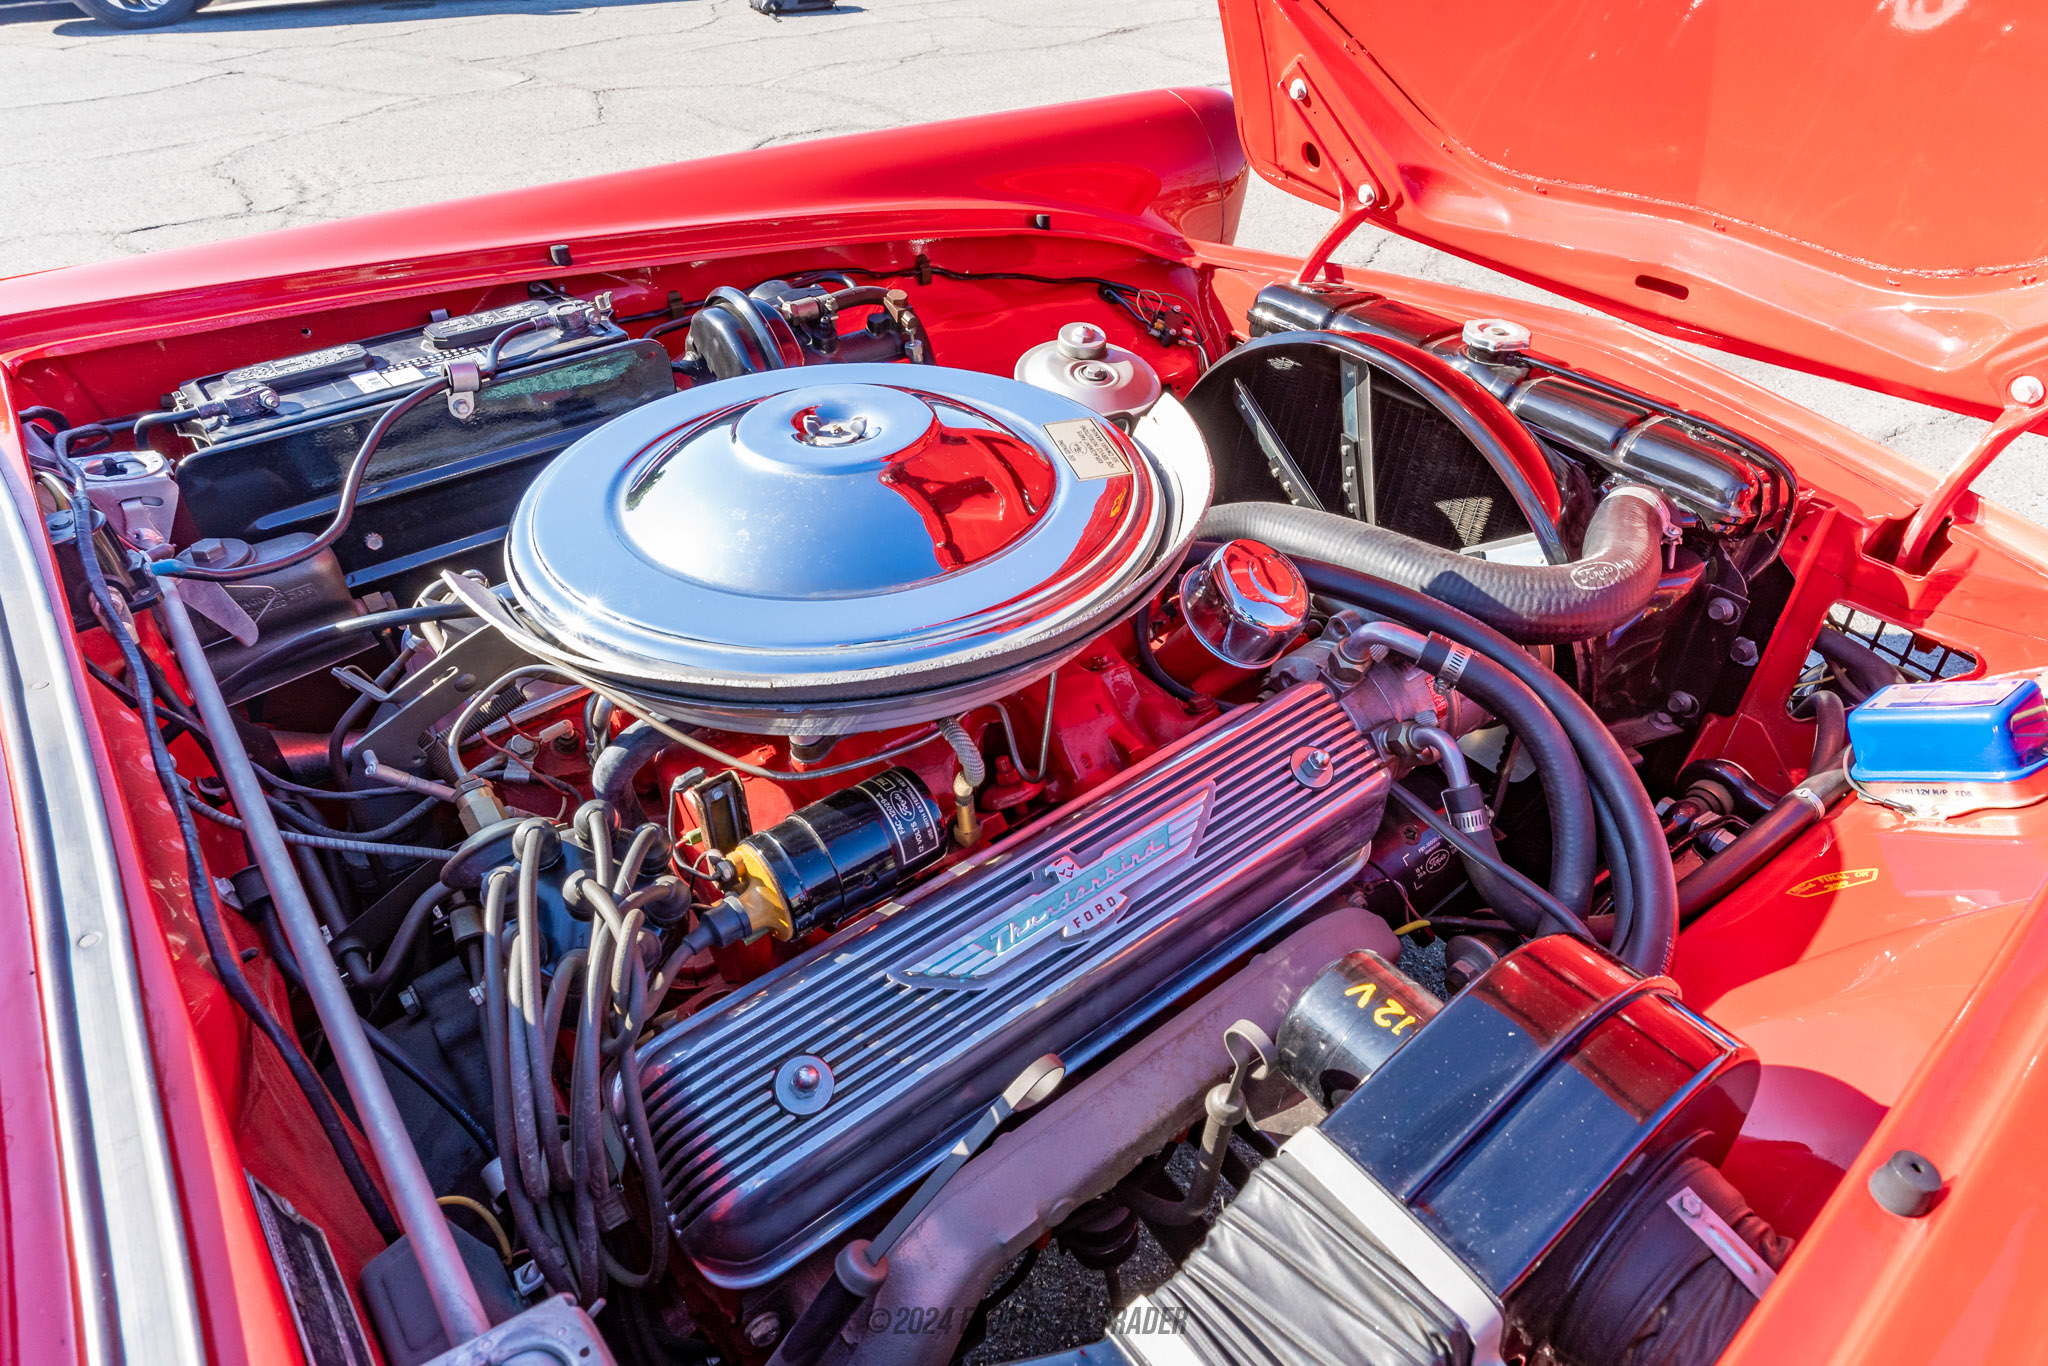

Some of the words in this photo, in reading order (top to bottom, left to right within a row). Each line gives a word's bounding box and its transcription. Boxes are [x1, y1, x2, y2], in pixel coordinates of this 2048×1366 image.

[1076, 431, 1086, 440] PARTS
[1084, 442, 1103, 463] REPLACEMENT
[1096, 446, 1109, 460] SERVICE
[905, 787, 924, 813] EXTERNAL
[921, 812, 931, 828] WITH
[910, 821, 923, 845] VOLTS
[990, 839, 1165, 957] Thunderbird
[1072, 896, 1116, 929] FORD
